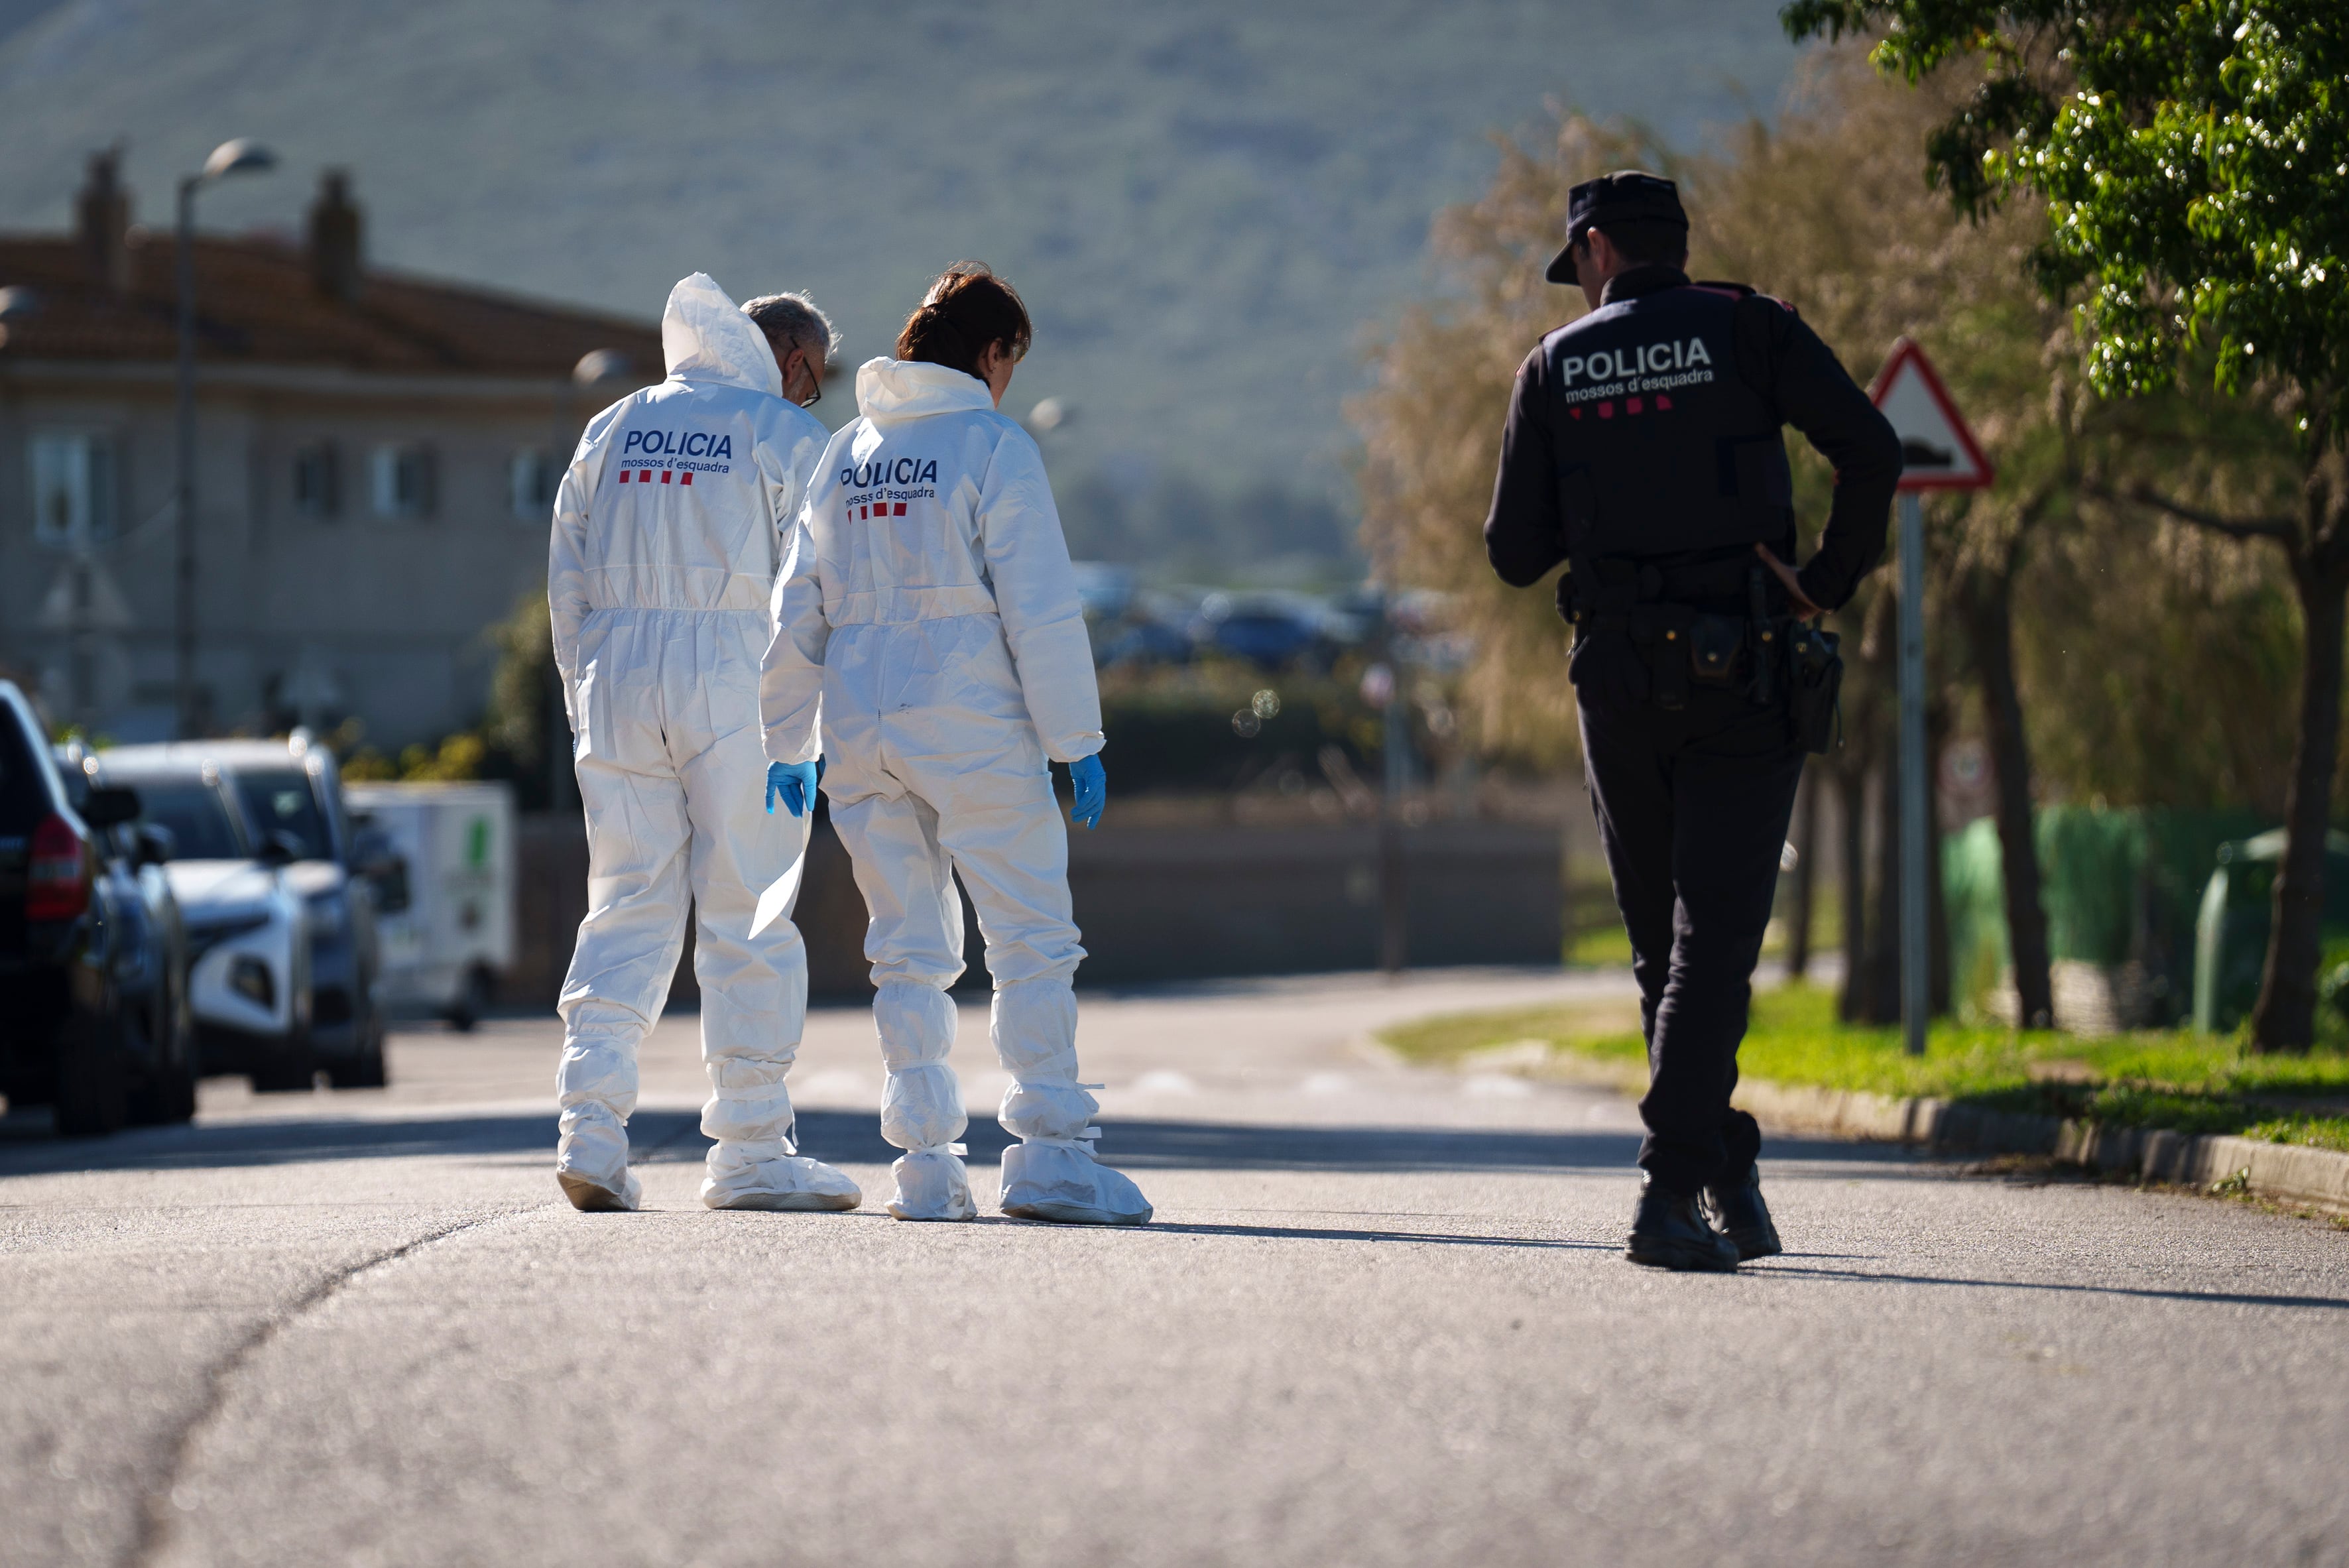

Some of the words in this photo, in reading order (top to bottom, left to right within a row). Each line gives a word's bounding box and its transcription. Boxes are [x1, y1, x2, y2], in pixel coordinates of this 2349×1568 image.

[1562, 337, 1711, 387] POLICIA
[1565, 382, 1624, 404] mossos
[623, 430, 732, 459] POLICIA
[621, 459, 664, 468] mossos
[666, 457, 729, 473] d'esquadra
[840, 457, 937, 489] POLICIA
[876, 486, 934, 501] d'esquadra
